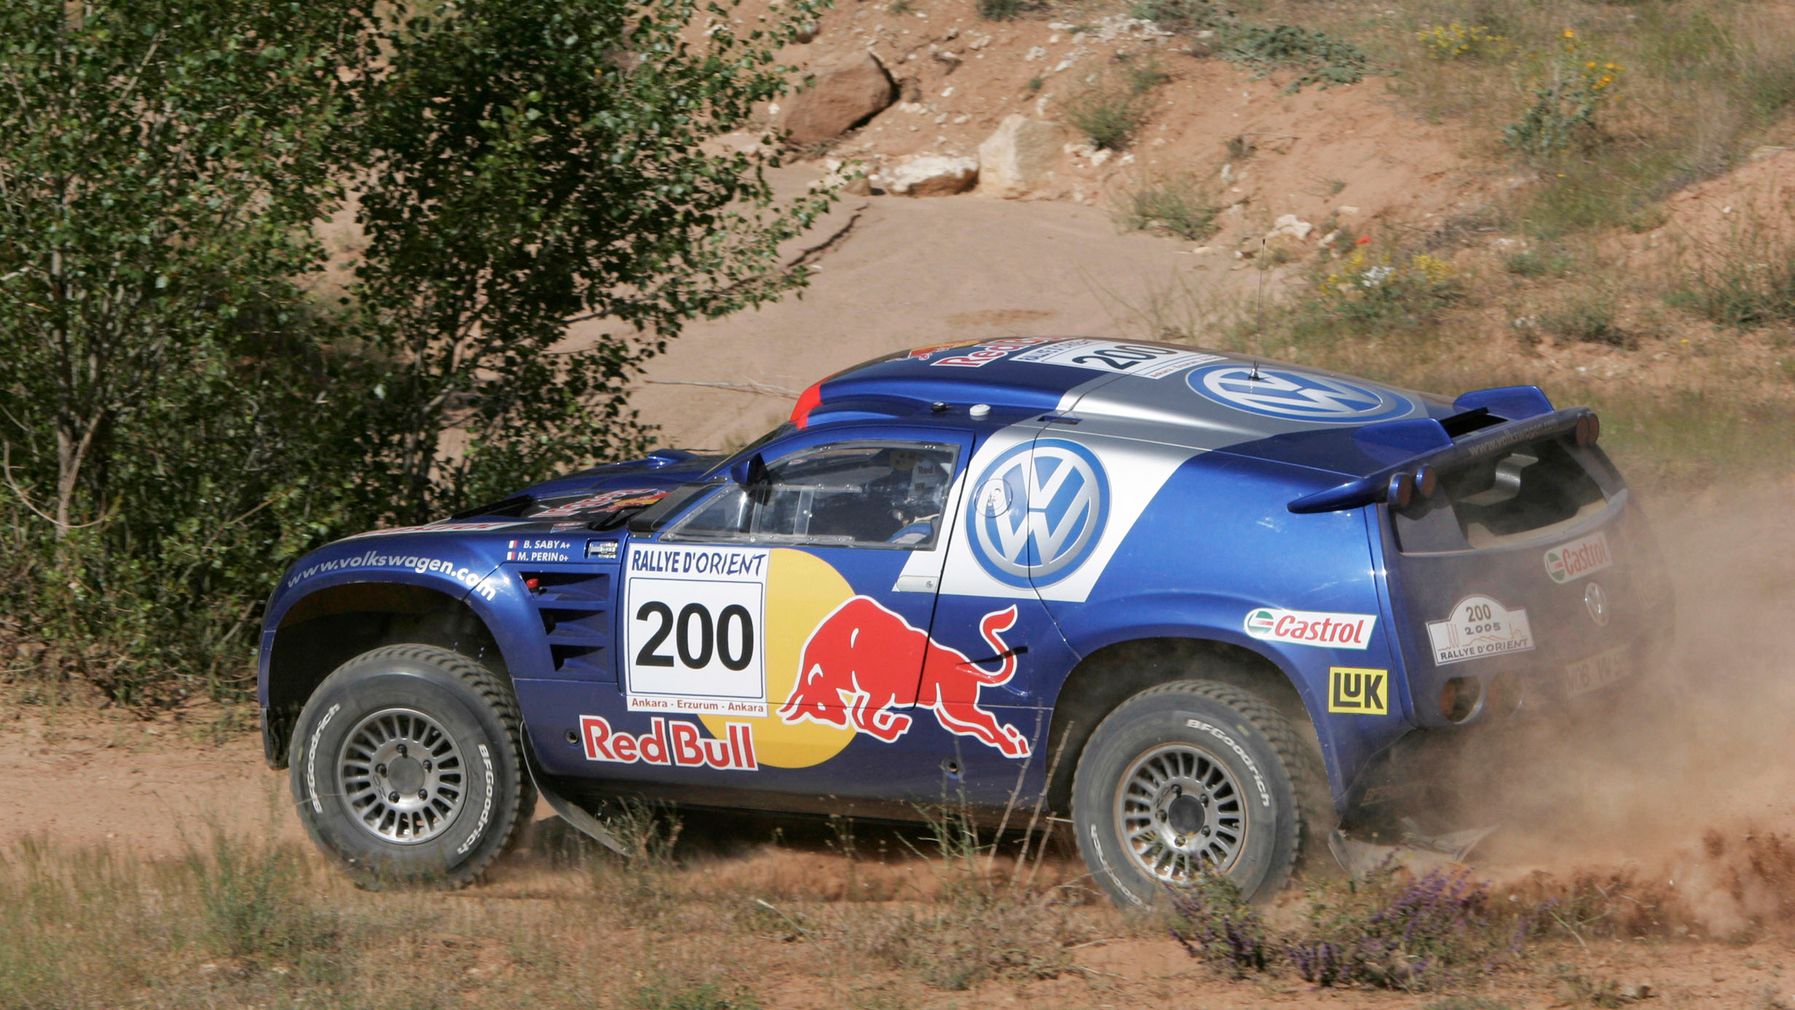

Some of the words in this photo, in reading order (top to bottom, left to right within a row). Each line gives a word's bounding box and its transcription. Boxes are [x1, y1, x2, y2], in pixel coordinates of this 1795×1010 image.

[1072, 345, 1177, 370] 200
[517, 552, 529, 561] M.
[531, 552, 558, 561] PERIN
[523, 540, 532, 549] B.
[534, 540, 560, 549] SABY
[631, 550, 681, 573] RALLYE
[682, 551, 767, 577] D'ORIENT
[1562, 543, 1608, 576] Castrol
[287, 551, 496, 601] www.volkswagen.com
[1466, 603, 1491, 622] 200
[635, 600, 754, 671] 200
[1274, 615, 1364, 644] Castrol
[1464, 622, 1501, 635] 2005
[1441, 647, 1475, 661] RALLYE
[1477, 638, 1529, 654] D'ORIENT
[631, 698, 668, 708] Ankara
[677, 700, 718, 710] Erzurum
[728, 702, 764, 712] Ankara
[580, 715, 671, 766] Red
[668, 720, 759, 771] Bull
[306, 703, 341, 814] BFGoodrich
[1186, 718, 1270, 807] BFGoodrich
[457, 743, 495, 855] BFGoodrich
